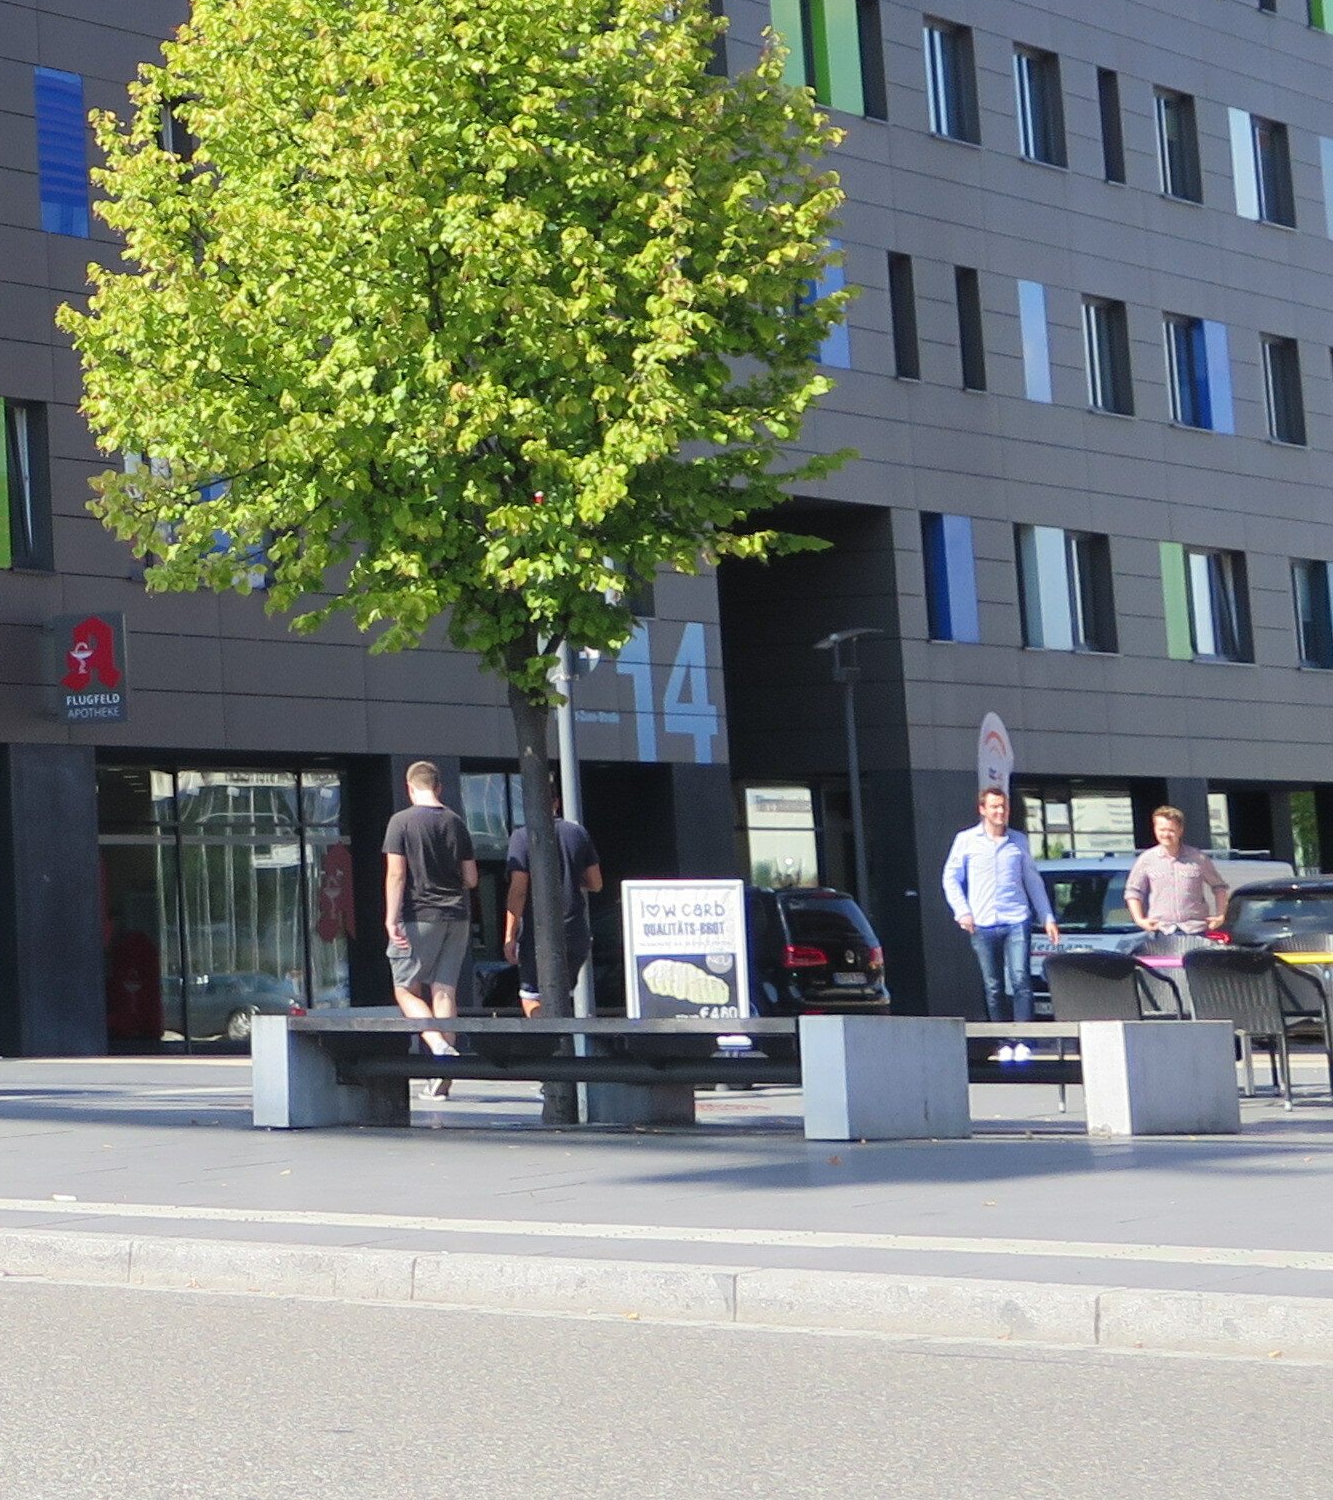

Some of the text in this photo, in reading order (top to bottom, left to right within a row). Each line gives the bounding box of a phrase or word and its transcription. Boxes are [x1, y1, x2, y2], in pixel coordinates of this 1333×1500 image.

[66, 693, 120, 706] FLUGFELD
[616, 622, 718, 764] 14
[67, 706, 121, 719] APOTHEKE
